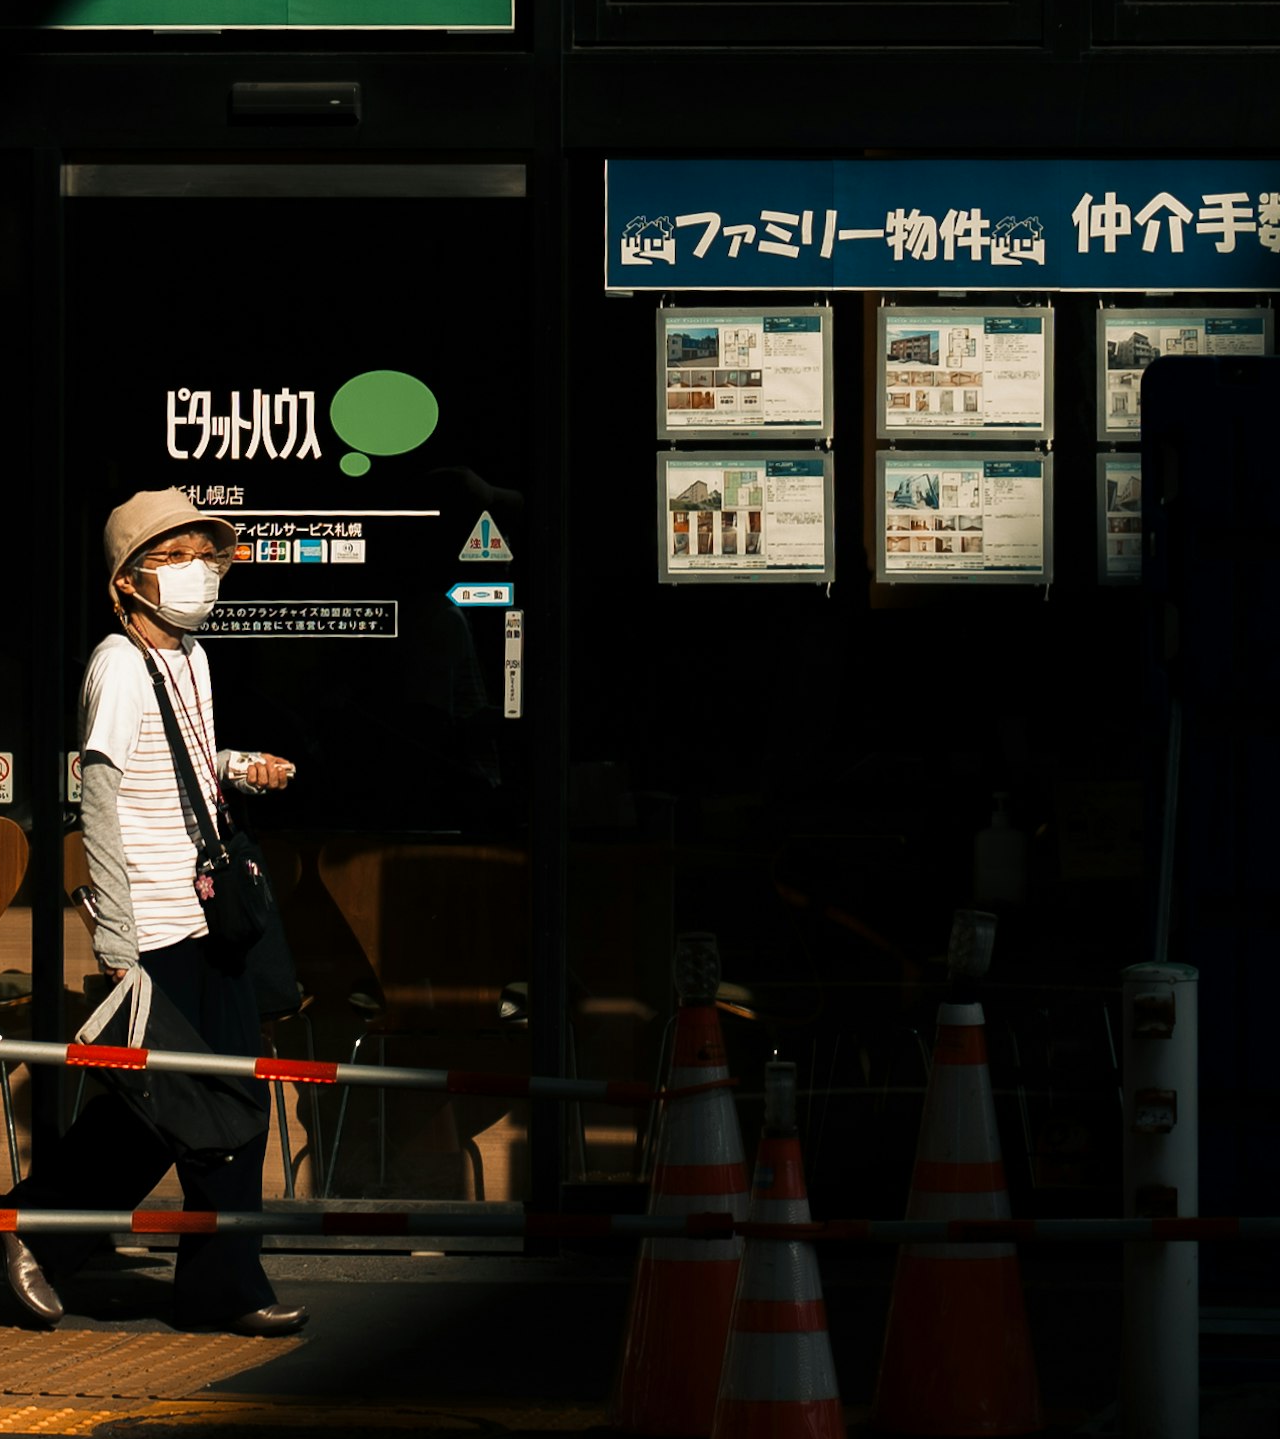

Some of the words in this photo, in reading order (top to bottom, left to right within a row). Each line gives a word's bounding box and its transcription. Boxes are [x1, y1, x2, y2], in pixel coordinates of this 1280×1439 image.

[676, 209, 991, 262] ファミリー物件
[166, 387, 322, 460] ピタットハウス
[172, 484, 245, 506] 札幌店
